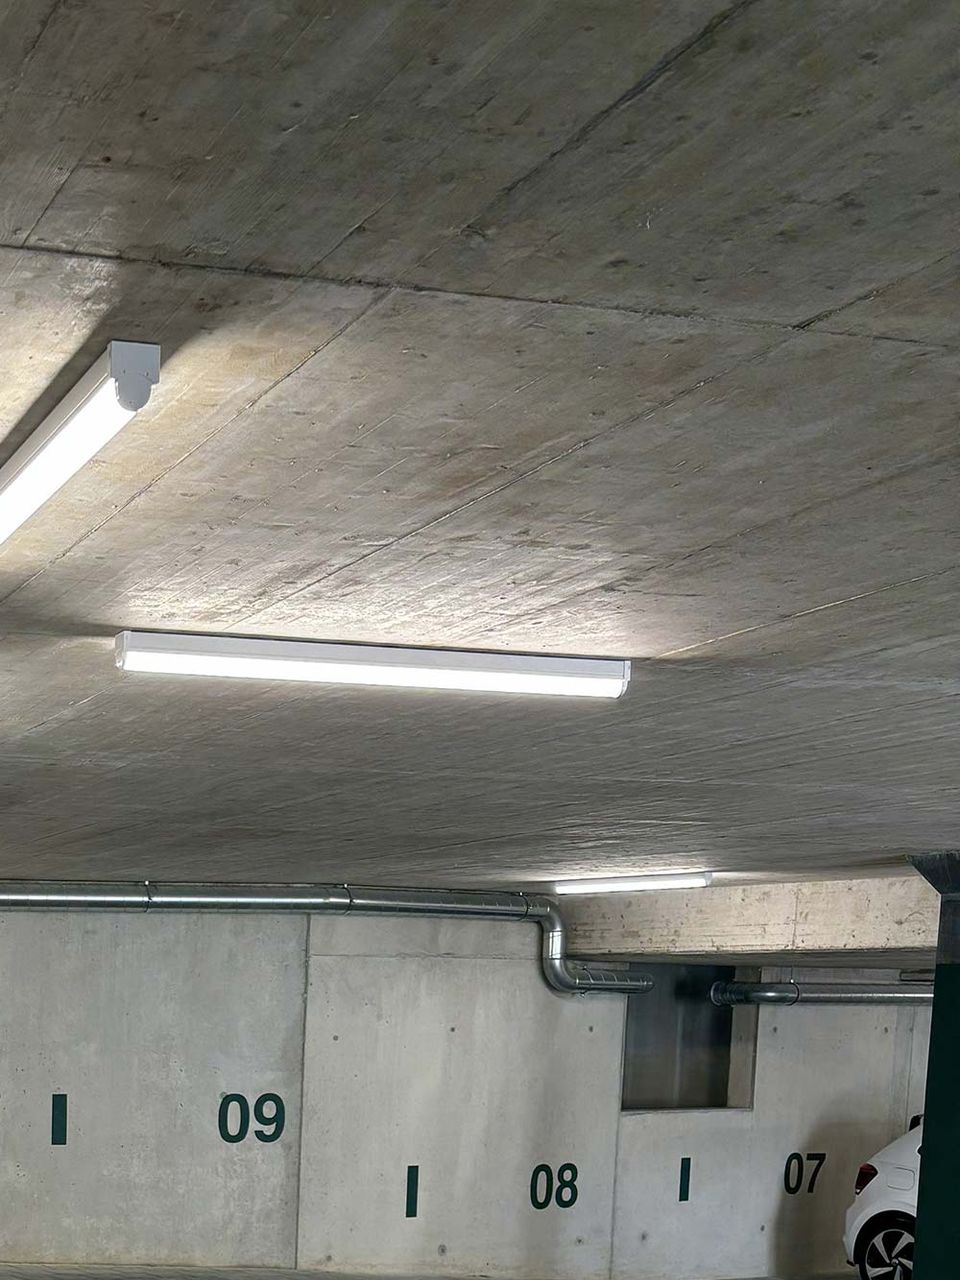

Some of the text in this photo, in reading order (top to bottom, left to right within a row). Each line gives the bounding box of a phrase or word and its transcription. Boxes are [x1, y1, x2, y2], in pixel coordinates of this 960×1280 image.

[218, 1093, 285, 1143] 09
[530, 1163, 579, 1209] 08
[783, 1152, 826, 1195] 07
